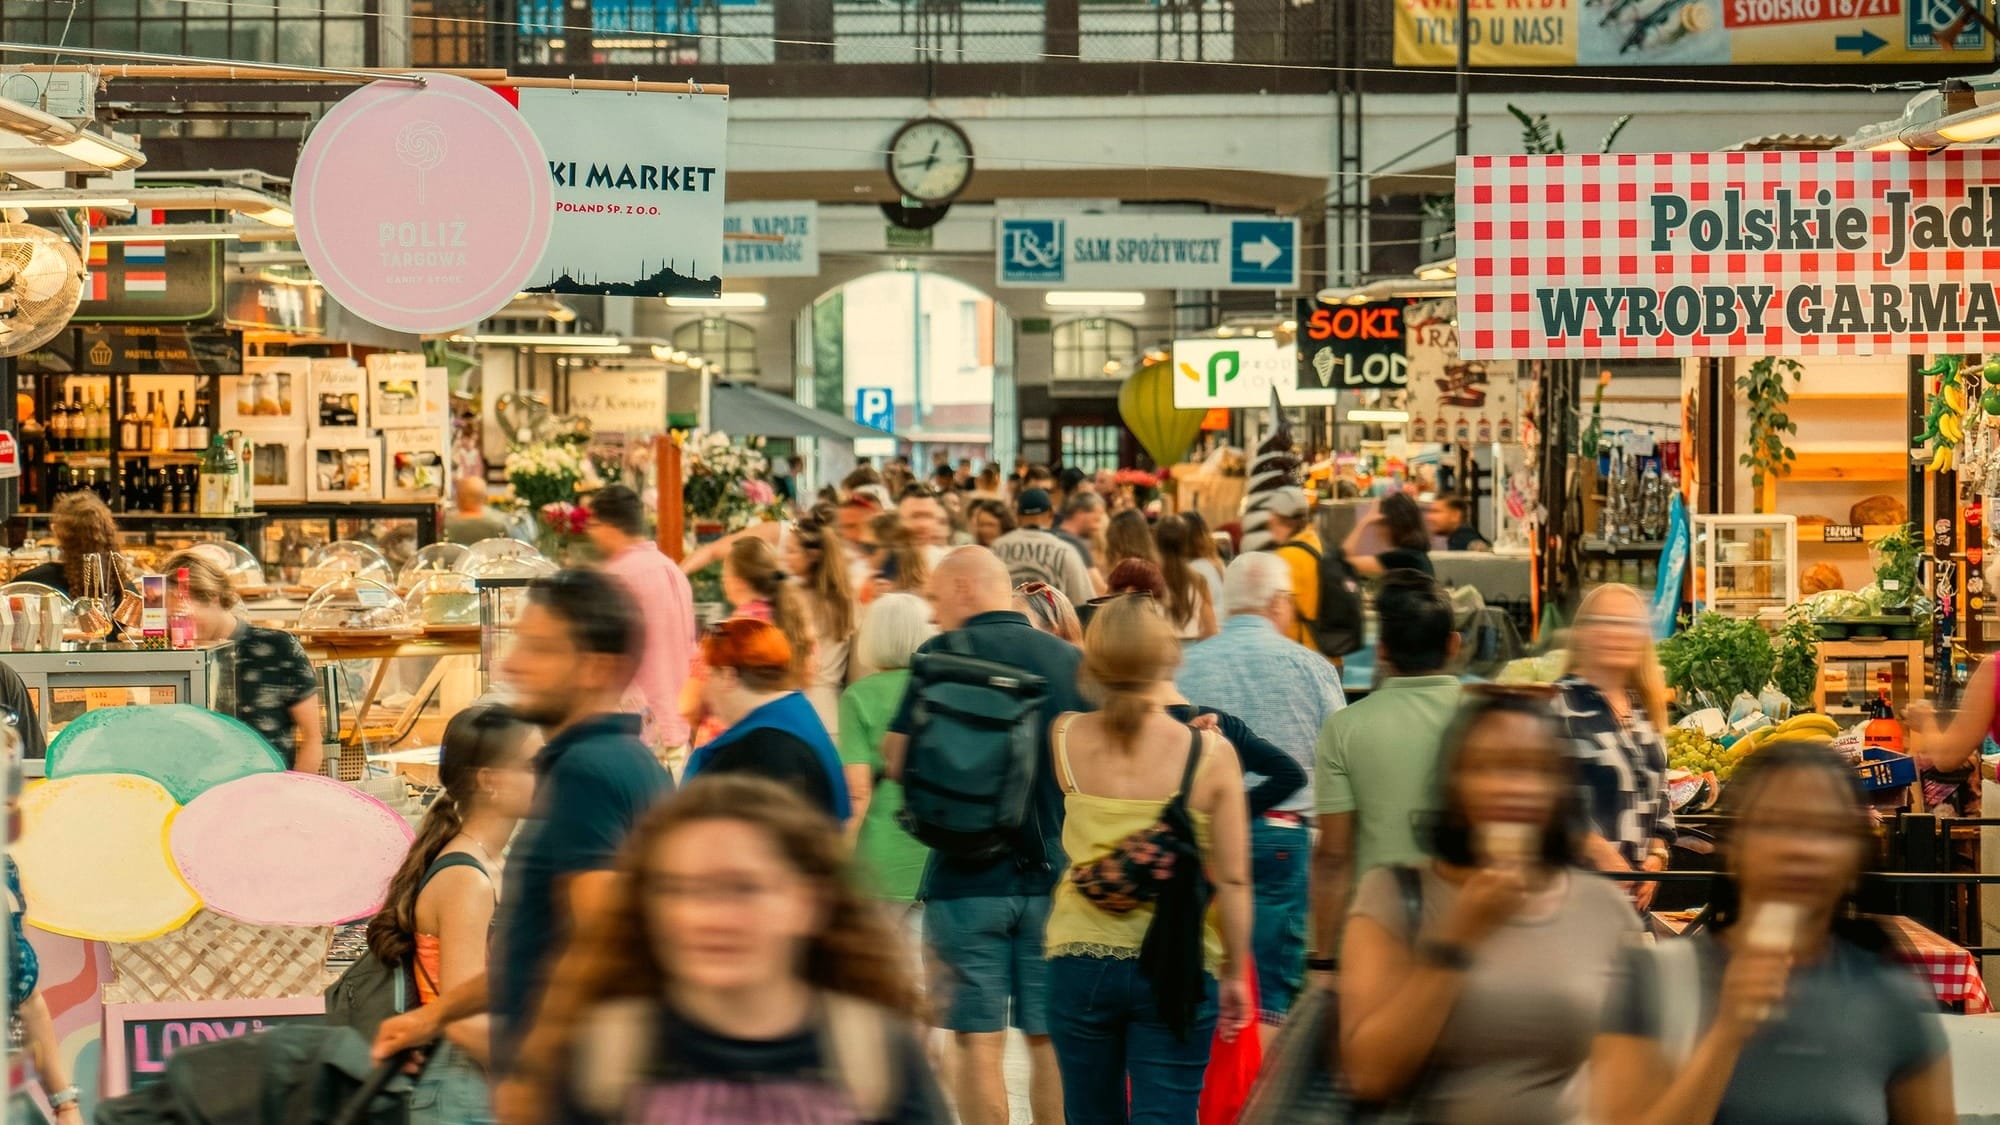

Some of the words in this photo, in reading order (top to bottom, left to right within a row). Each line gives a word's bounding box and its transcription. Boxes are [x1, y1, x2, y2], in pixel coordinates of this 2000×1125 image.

[1490, 18, 1504, 45] U
[1514, 17, 1563, 45] NAS!
[549, 161, 576, 186] KI
[586, 163, 716, 192] MARKET
[556, 202, 604, 213] POLAND
[1651, 189, 1867, 251] Polskie
[752, 216, 808, 235] NAPOJE
[1074, 237, 1110, 263] SAM
[1116, 233, 1222, 264] SPOŻYWCZY
[1309, 308, 1399, 340] SOKI
[1537, 285, 1773, 336] WYROBY
[1786, 283, 2000, 335] GARMA
[863, 391, 887, 423] P
